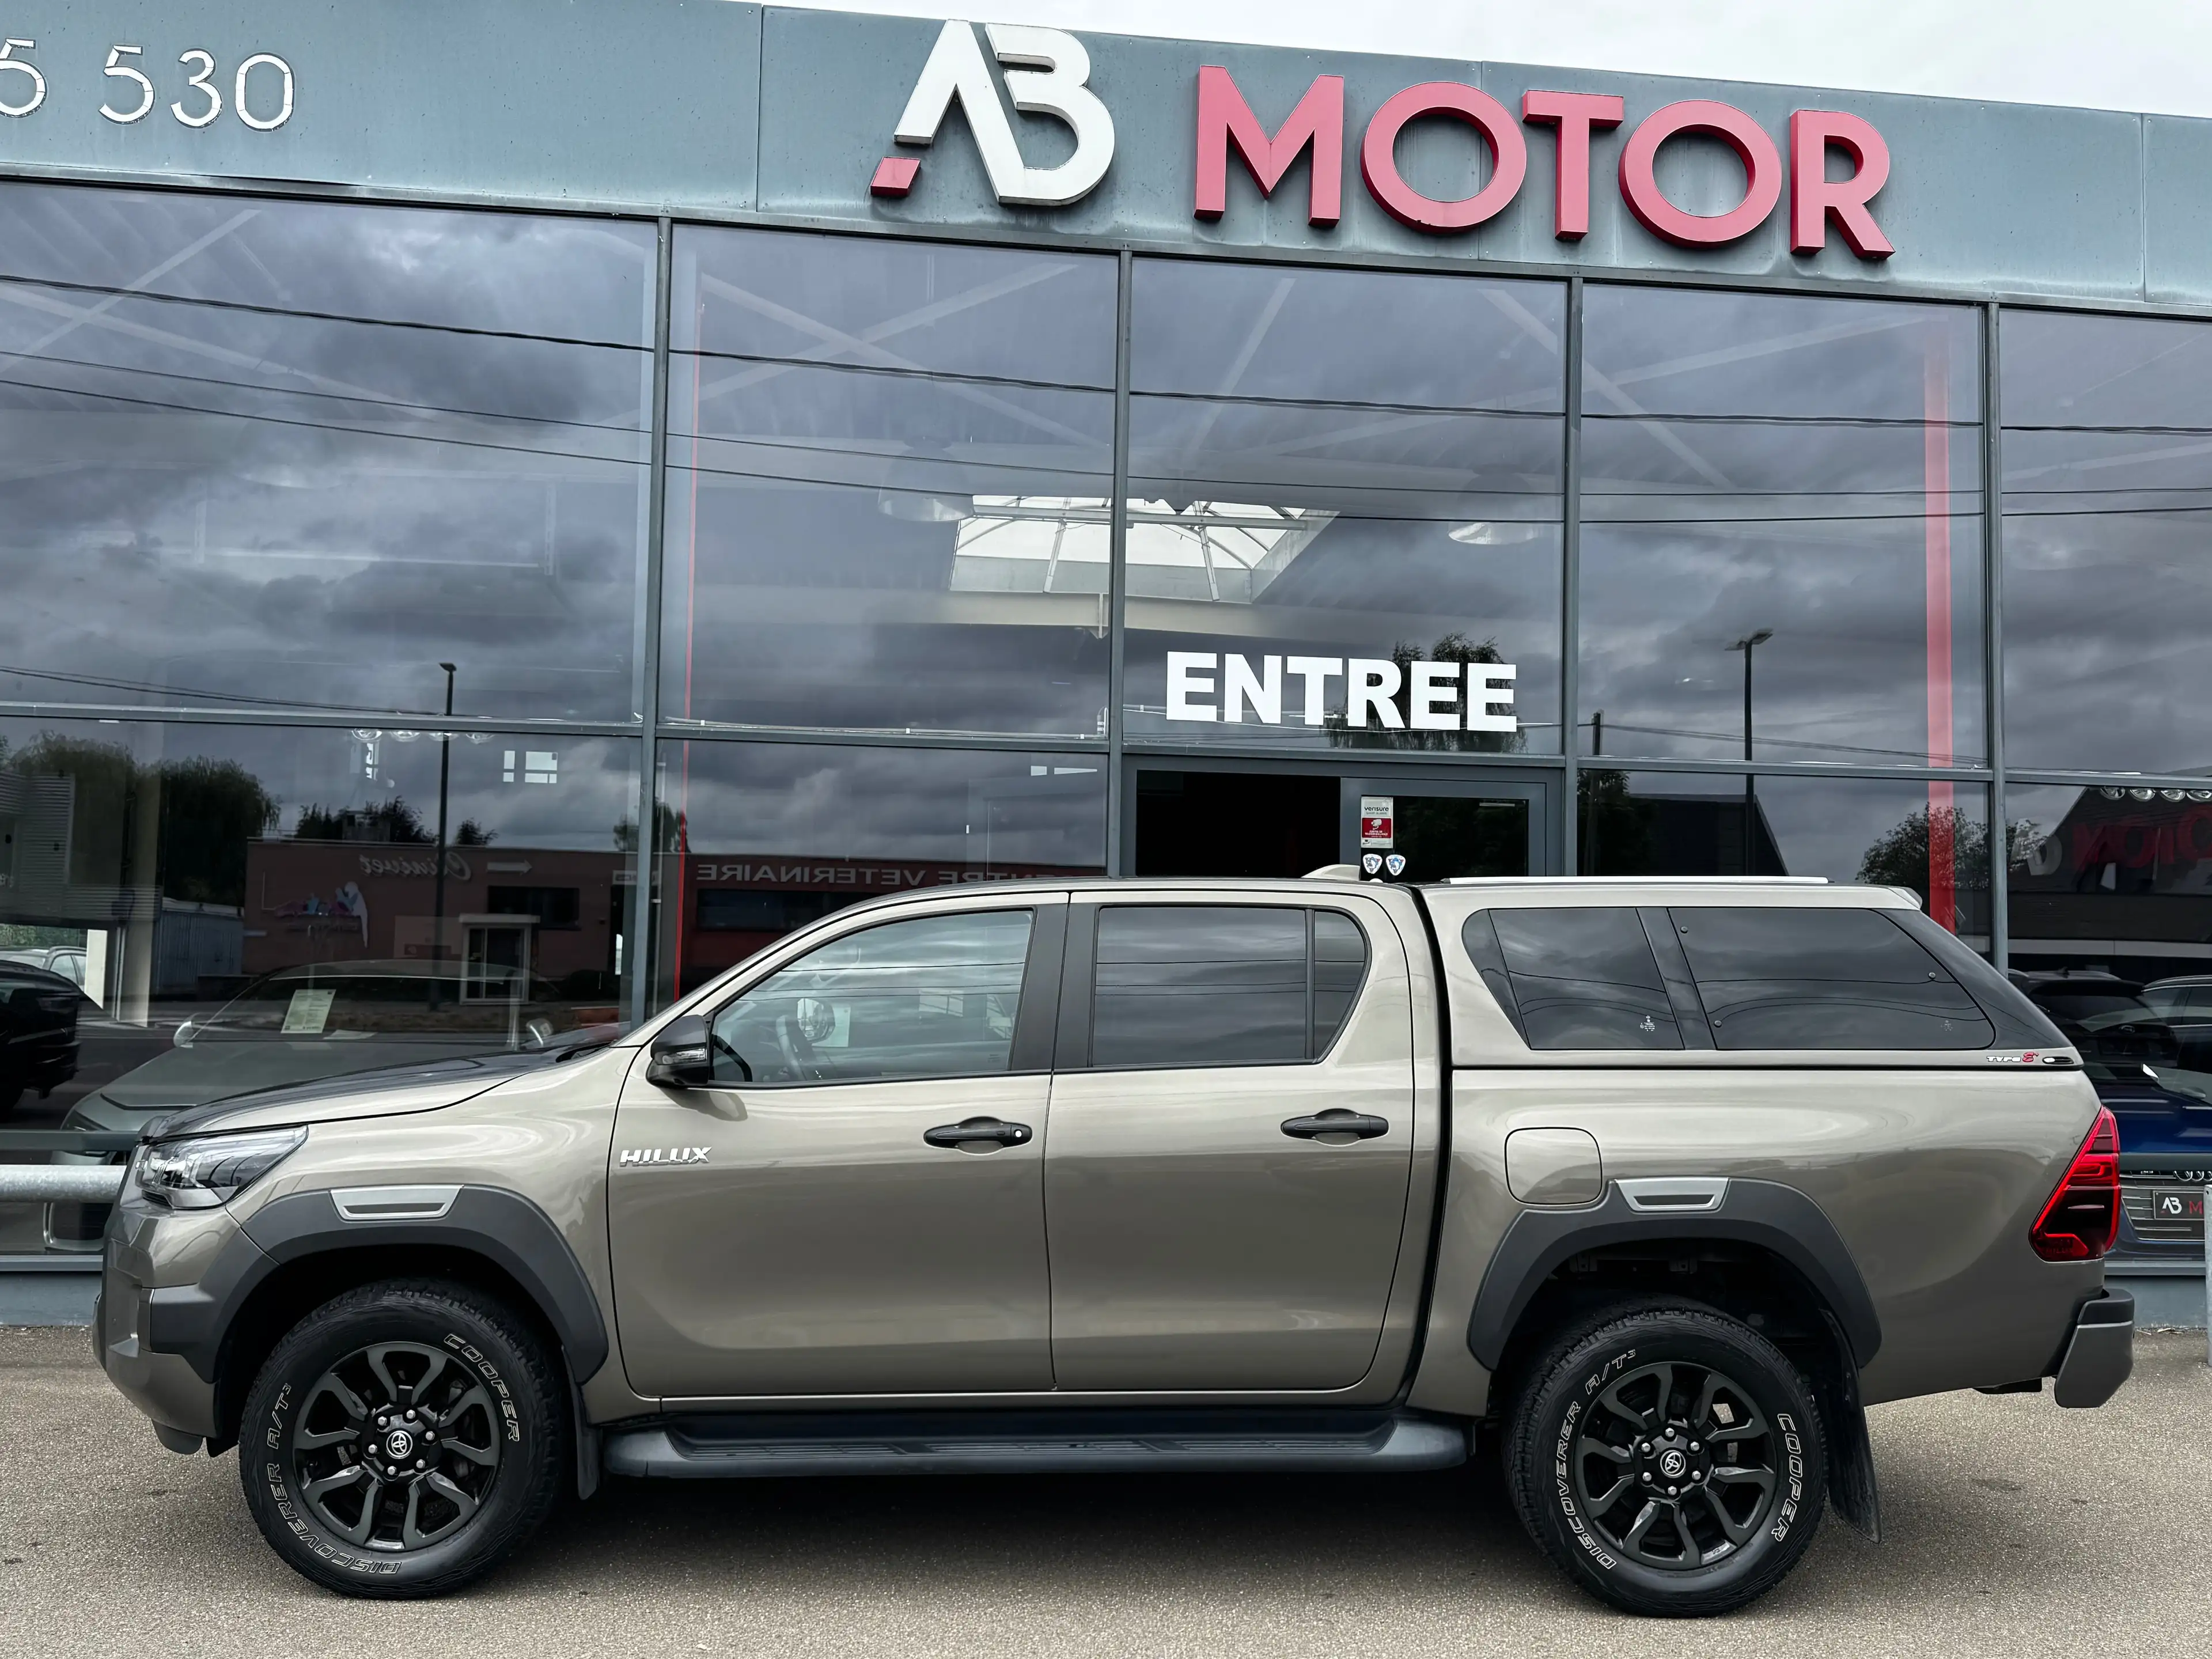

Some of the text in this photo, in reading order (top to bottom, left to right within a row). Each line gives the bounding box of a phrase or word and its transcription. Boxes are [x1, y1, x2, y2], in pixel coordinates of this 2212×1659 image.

[98, 45, 295, 132] 530
[870, 19, 1895, 259] AB MOTOR
[1166, 651, 1517, 732] ENTREE
[619, 1146, 712, 1167] HILUX
[2160, 1197, 2182, 1214] AB
[444, 1334, 520, 1442] COOPER
[267, 1463, 402, 1574] DISCOVERER
[1556, 1401, 1617, 1570] DISCOVERER
[1771, 1414, 1803, 1542] COOPER
